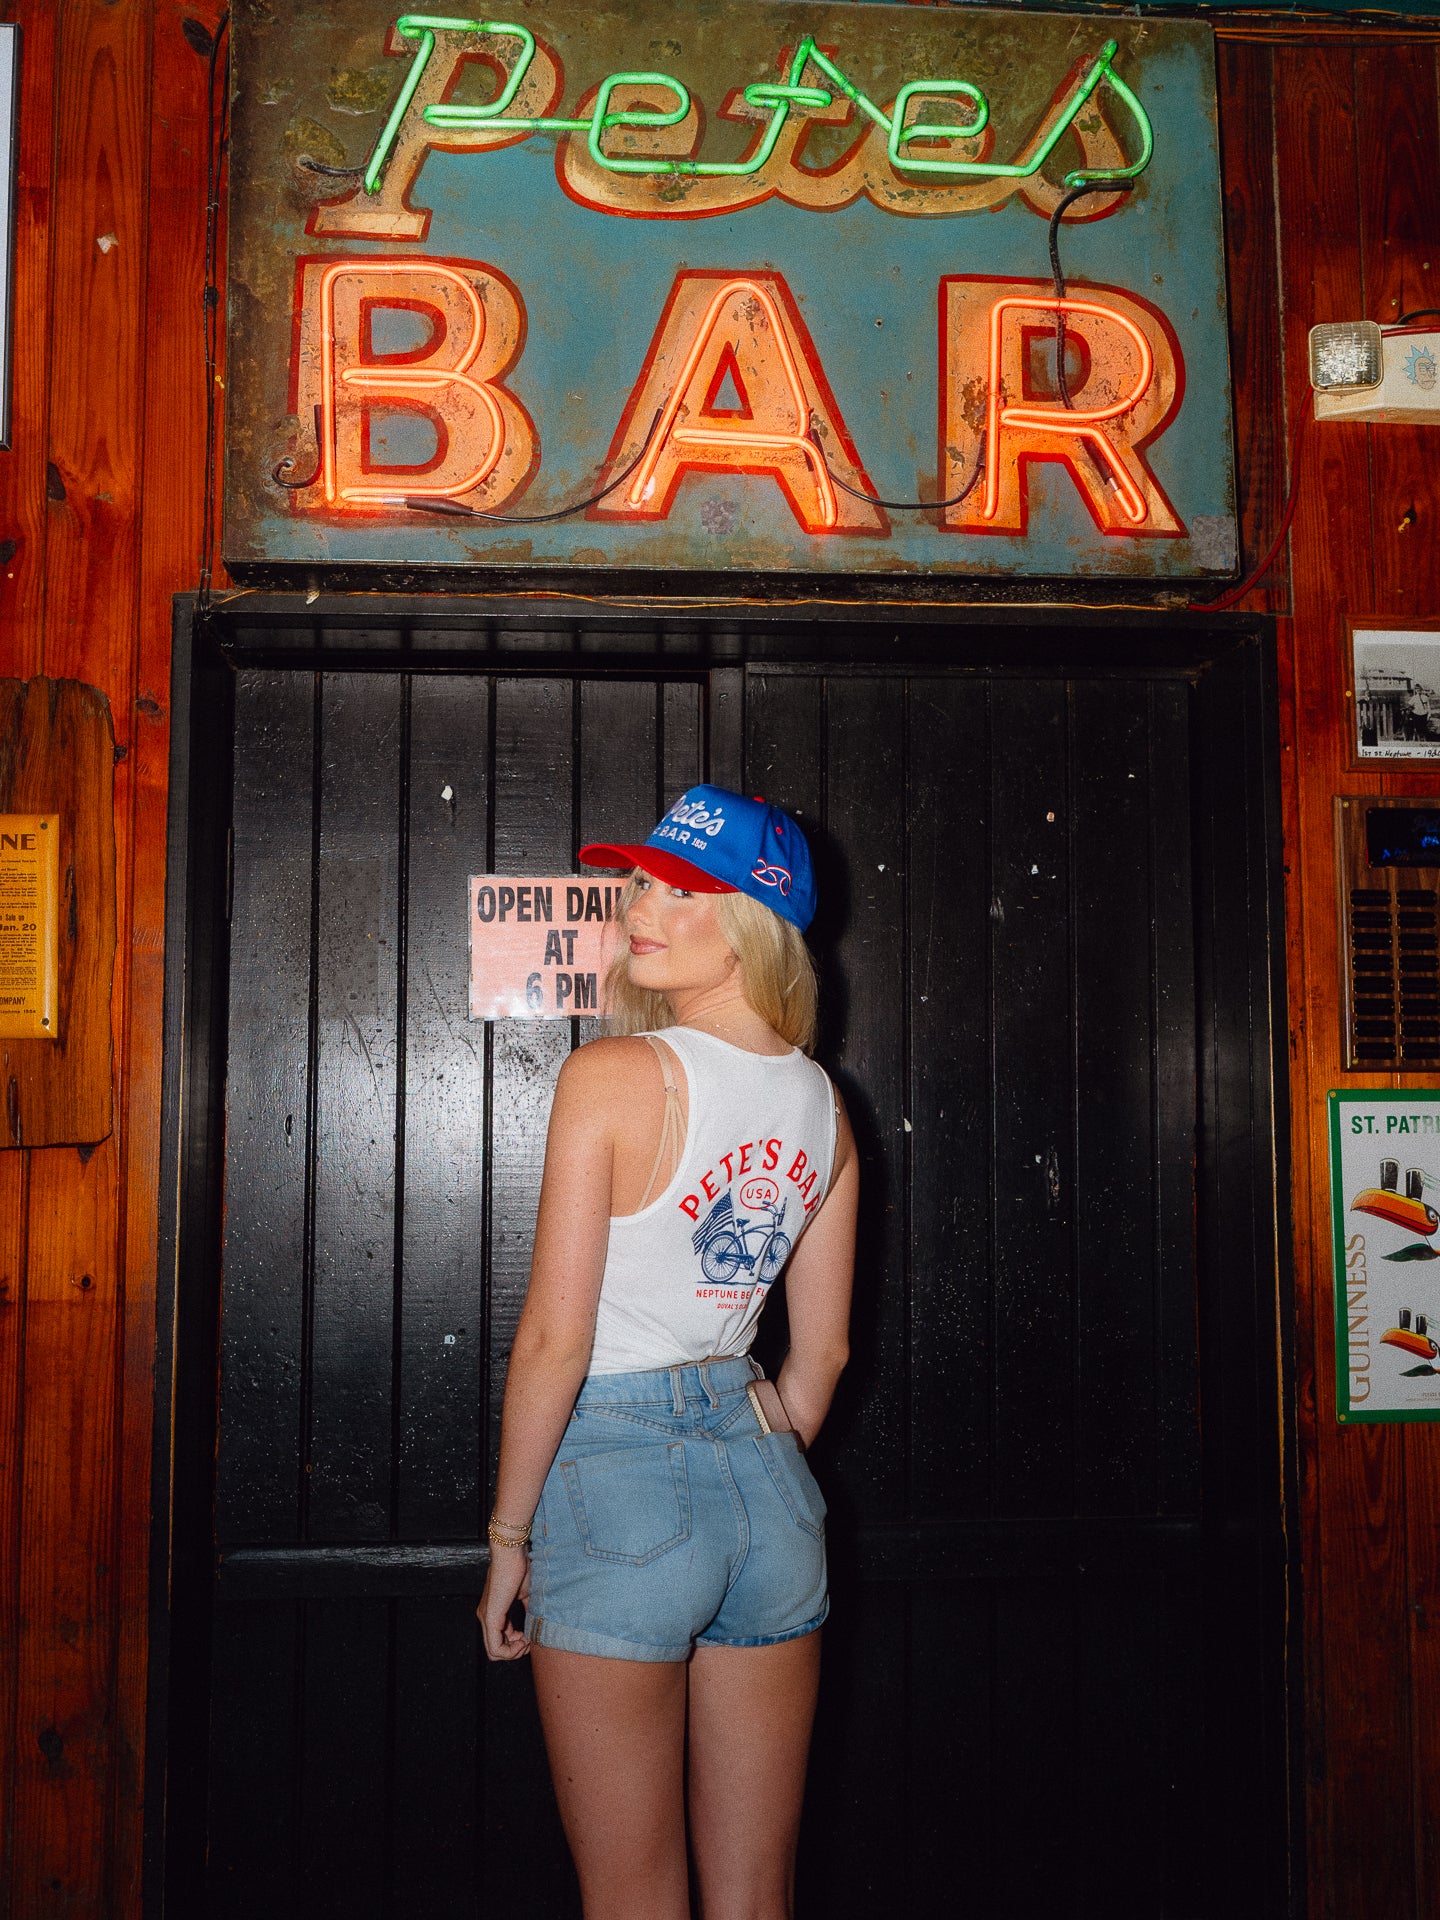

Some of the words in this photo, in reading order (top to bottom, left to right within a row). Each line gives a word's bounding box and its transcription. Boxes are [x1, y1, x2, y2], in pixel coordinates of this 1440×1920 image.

[290, 255, 1186, 537] BAR
[659, 825, 692, 845] BAR
[477, 885, 553, 923] OPEN
[22, 923, 37, 931] 20
[544, 929, 579, 966] AT
[526, 972, 544, 1010] 6
[556, 972, 598, 1009] PM
[1351, 1115, 1379, 1134] ST.
[678, 1138, 783, 1222] PETE'S
[746, 1188, 772, 1200] USA
[696, 1289, 738, 1299] NEPTUNE
[1346, 1233, 1371, 1403] GUINNESS
